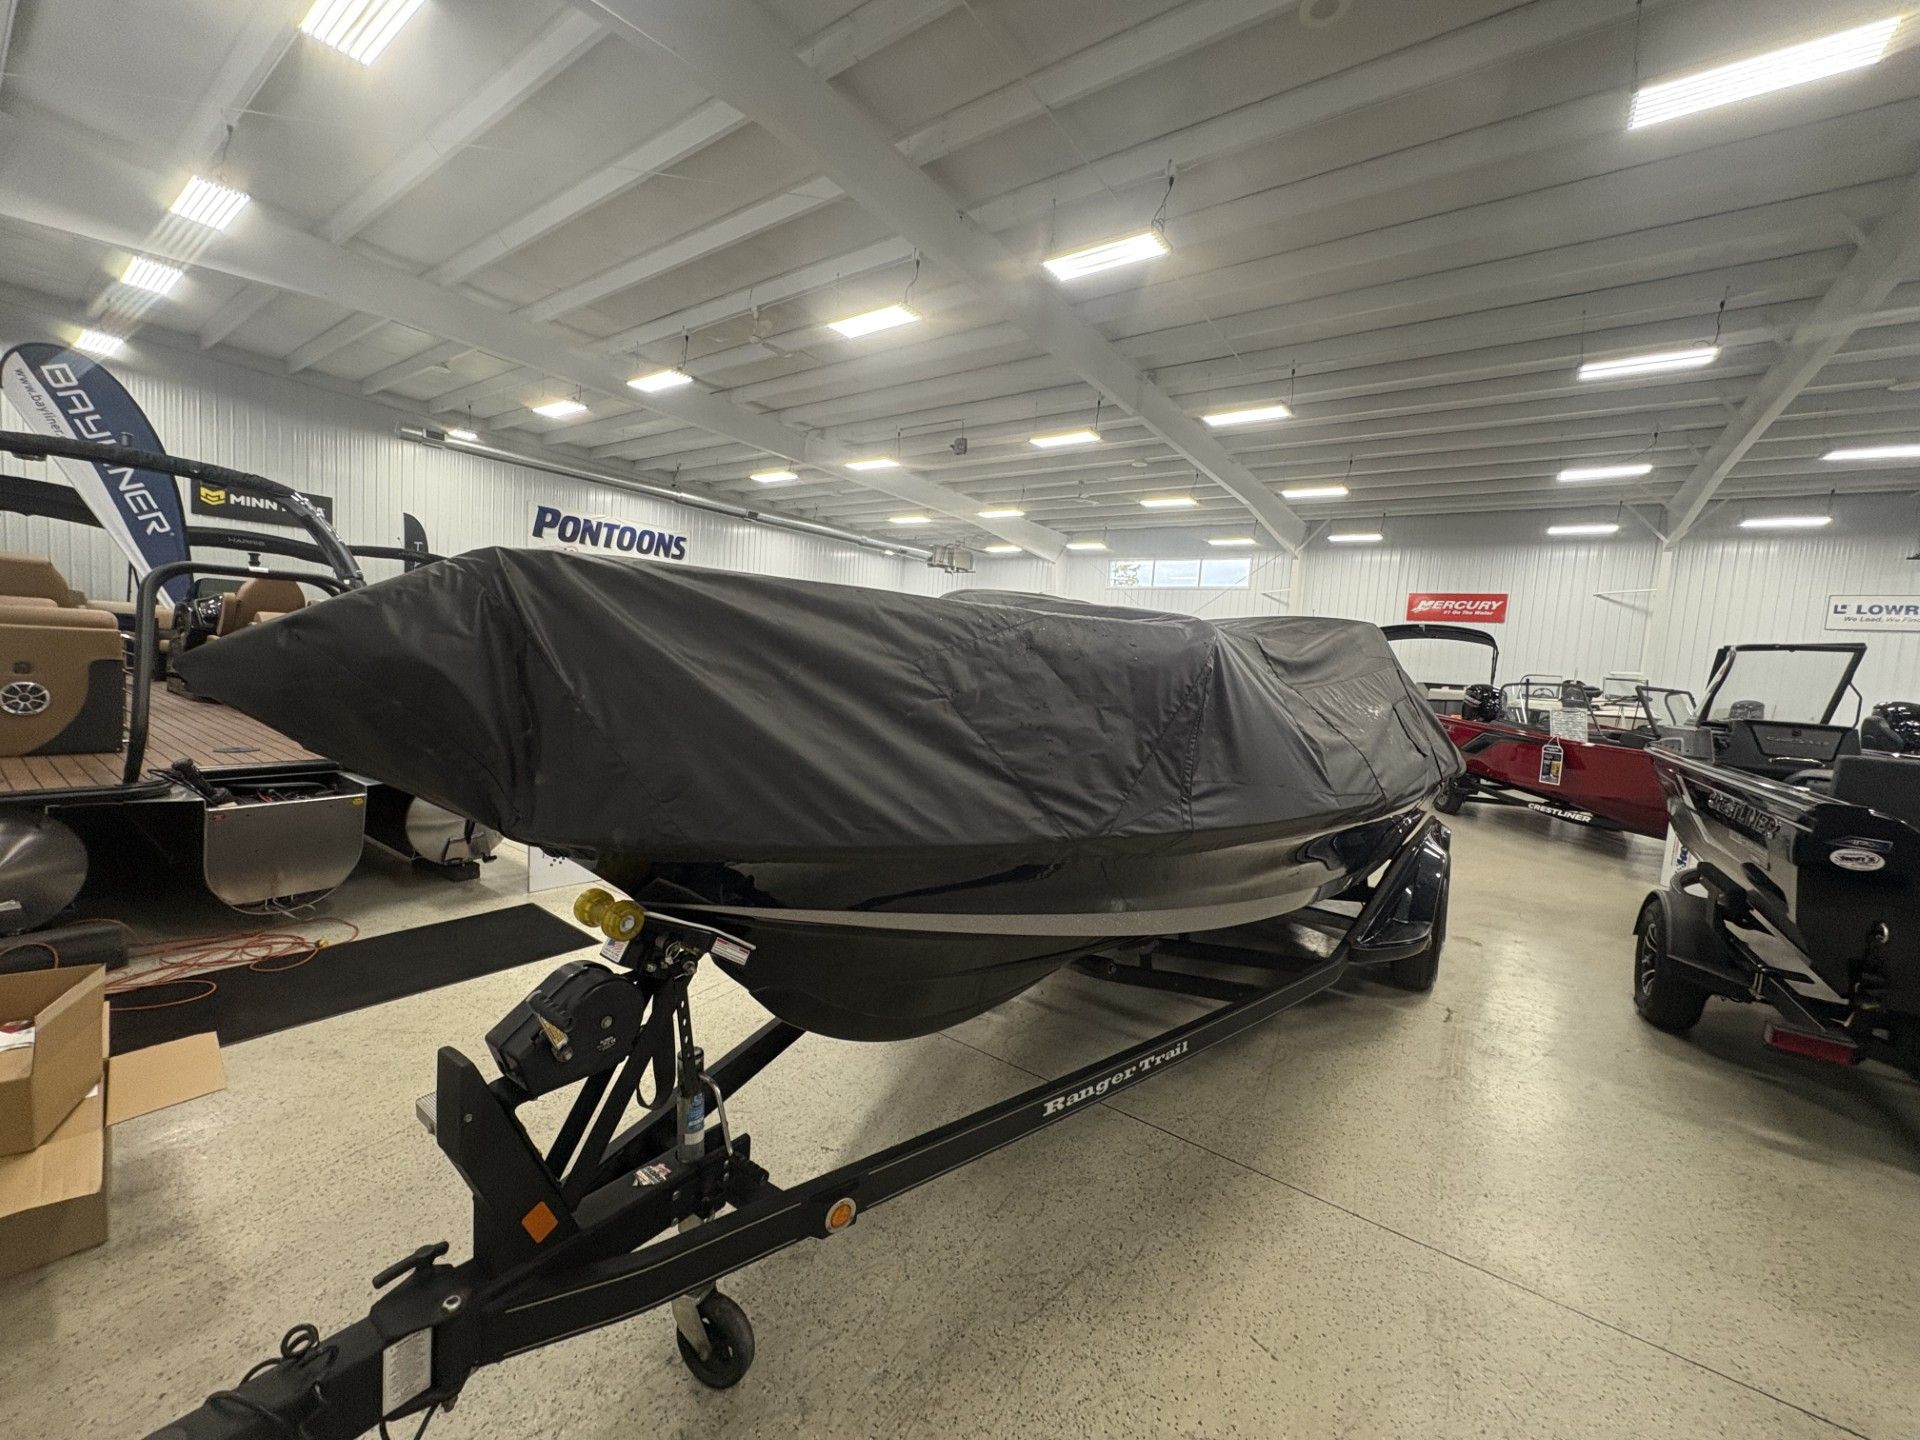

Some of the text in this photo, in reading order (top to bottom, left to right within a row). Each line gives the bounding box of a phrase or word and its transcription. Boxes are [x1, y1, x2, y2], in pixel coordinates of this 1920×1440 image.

[40, 363, 171, 535] BAYNER
[229, 493, 278, 511] MINN
[531, 505, 687, 560] PONTOONS
[1411, 600, 1504, 613] MERCURY
[1856, 604, 1919, 615] LOWR
[1528, 803, 1592, 823] CRESTLINER
[1042, 1041, 1189, 1117] Ranger Trail
